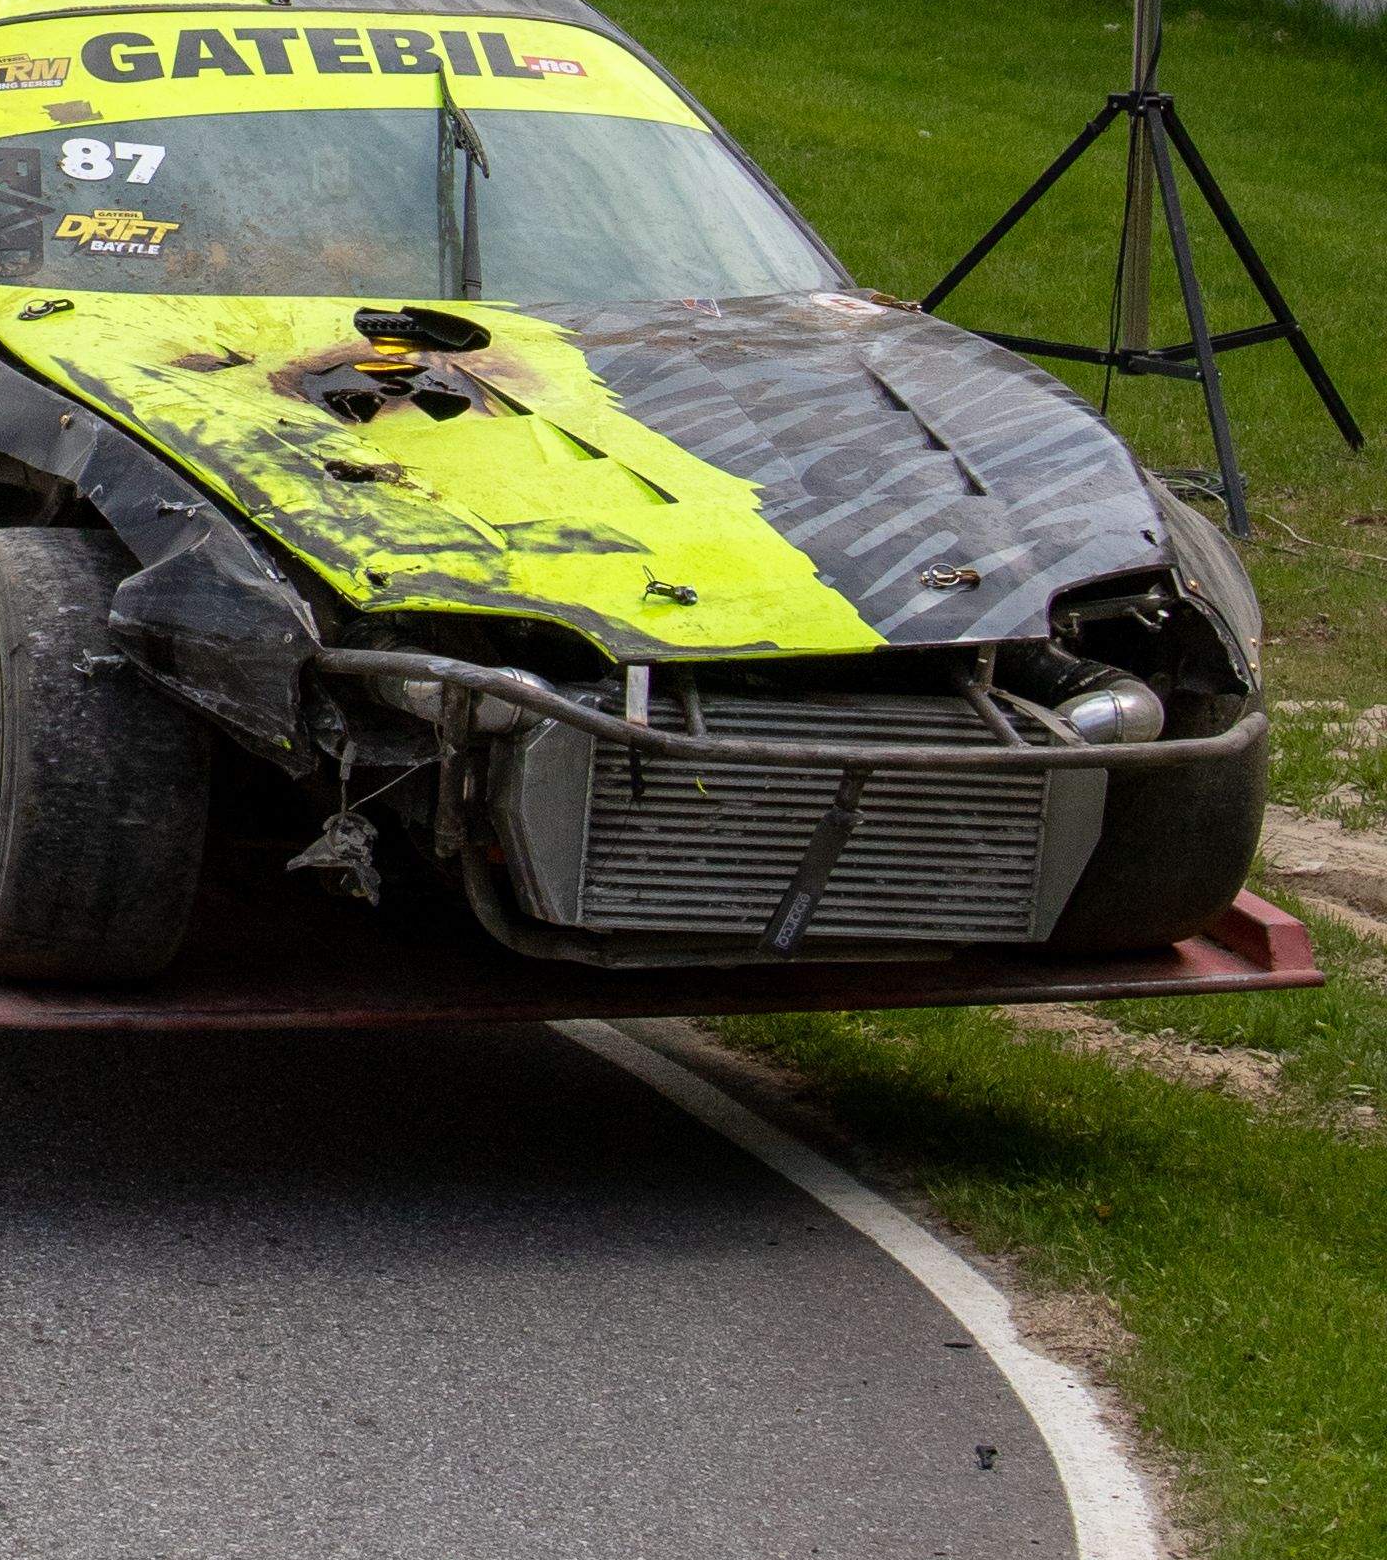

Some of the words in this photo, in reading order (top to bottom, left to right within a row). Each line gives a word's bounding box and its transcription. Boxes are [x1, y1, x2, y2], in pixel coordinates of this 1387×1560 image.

[20, 79, 62, 89] SERIES
[61, 137, 166, 185] 87
[54, 214, 180, 246] DRIFT
[90, 240, 162, 255] BATTLE
